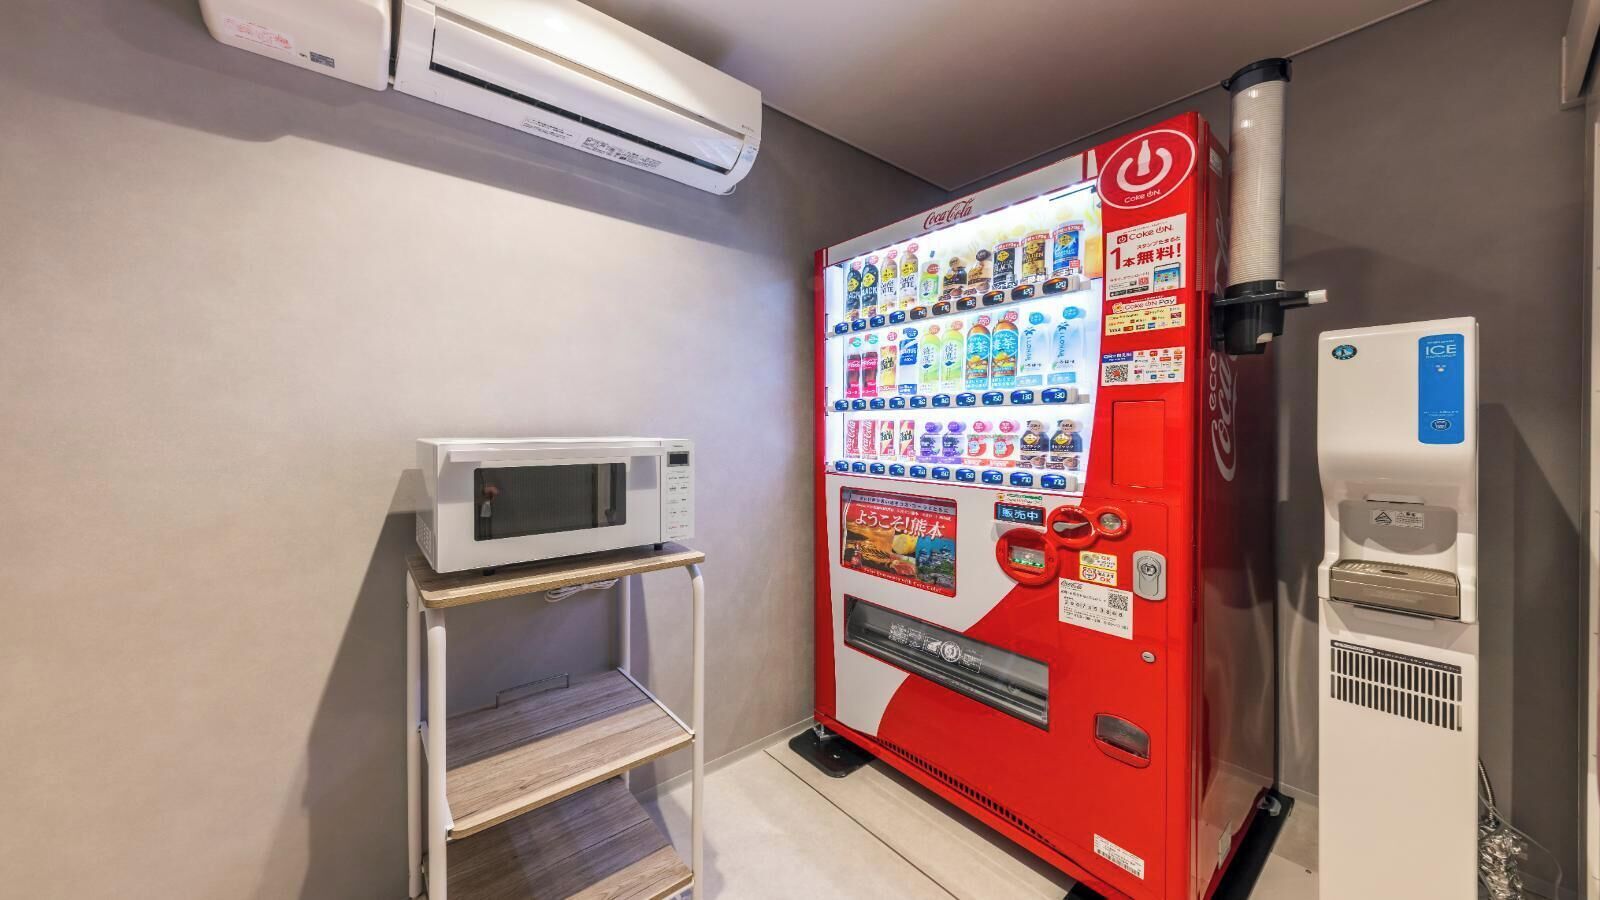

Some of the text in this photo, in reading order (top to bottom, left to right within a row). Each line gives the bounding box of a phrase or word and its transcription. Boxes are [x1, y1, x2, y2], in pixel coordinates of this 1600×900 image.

[1124, 193, 1145, 204] Coke
[923, 198, 975, 230] Coca-Cola
[1129, 230, 1154, 240] Coke
[1426, 345, 1456, 356] ICE
[1209, 352, 1217, 411] eco
[1002, 508, 1039, 520] 販売中
